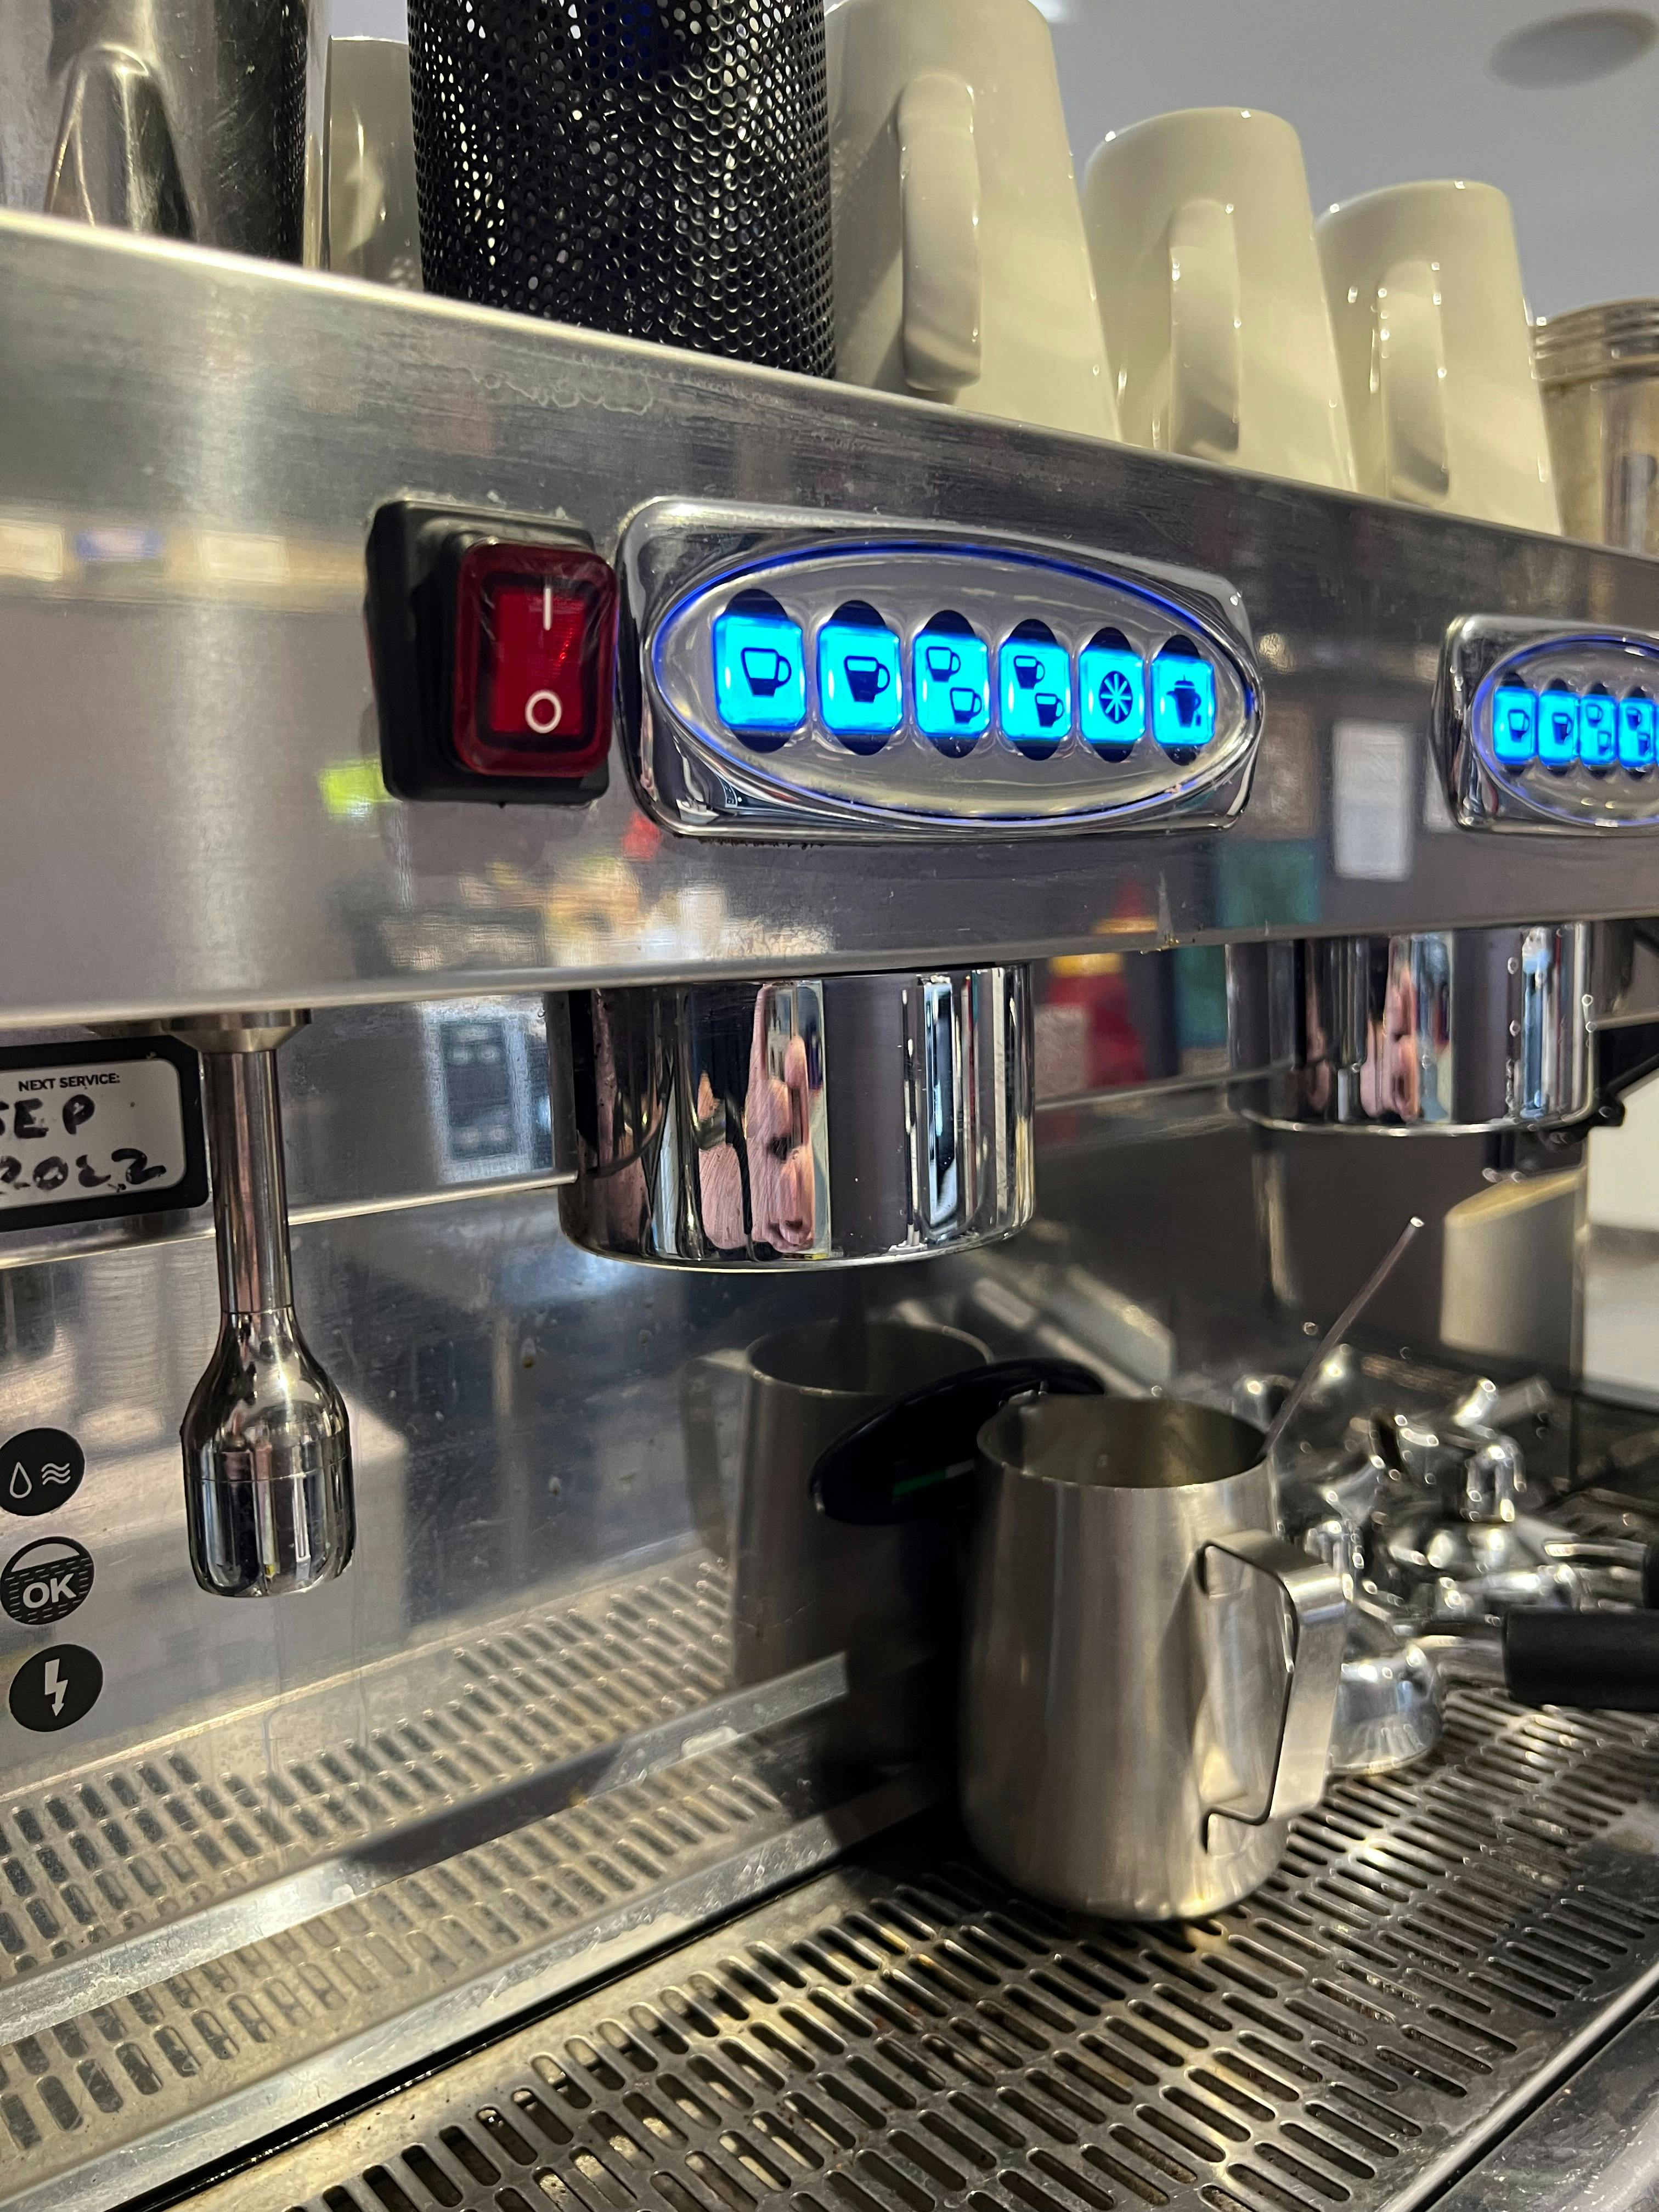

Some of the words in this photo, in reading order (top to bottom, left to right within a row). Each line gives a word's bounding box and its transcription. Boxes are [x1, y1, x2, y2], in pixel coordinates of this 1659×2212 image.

[18, 1078, 56, 1092] NEXT
[60, 1073, 120, 1088] SERVICE:
[22, 1573, 77, 1609] OK
